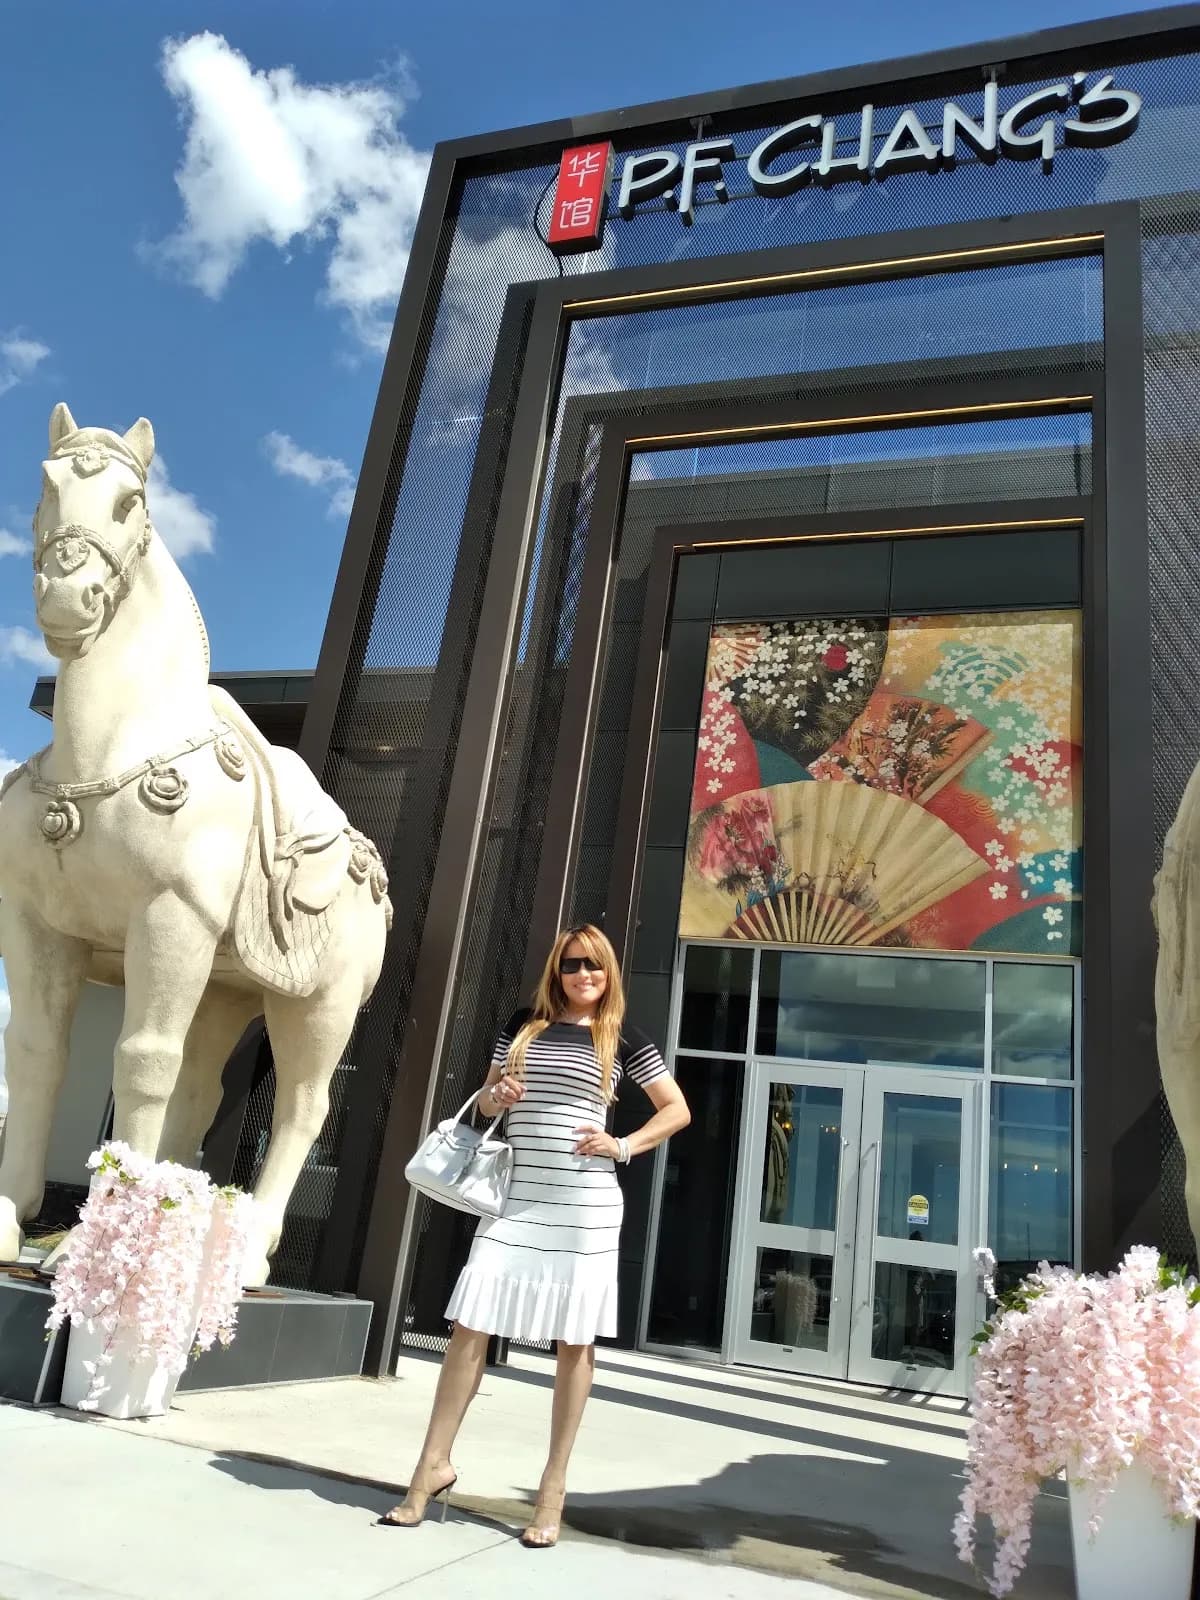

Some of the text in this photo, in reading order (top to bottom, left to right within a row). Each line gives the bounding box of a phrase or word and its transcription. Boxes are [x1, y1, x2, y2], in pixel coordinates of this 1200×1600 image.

[559, 151, 601, 230] 华馆
[618, 72, 1142, 213] P.F. CHANG'S
